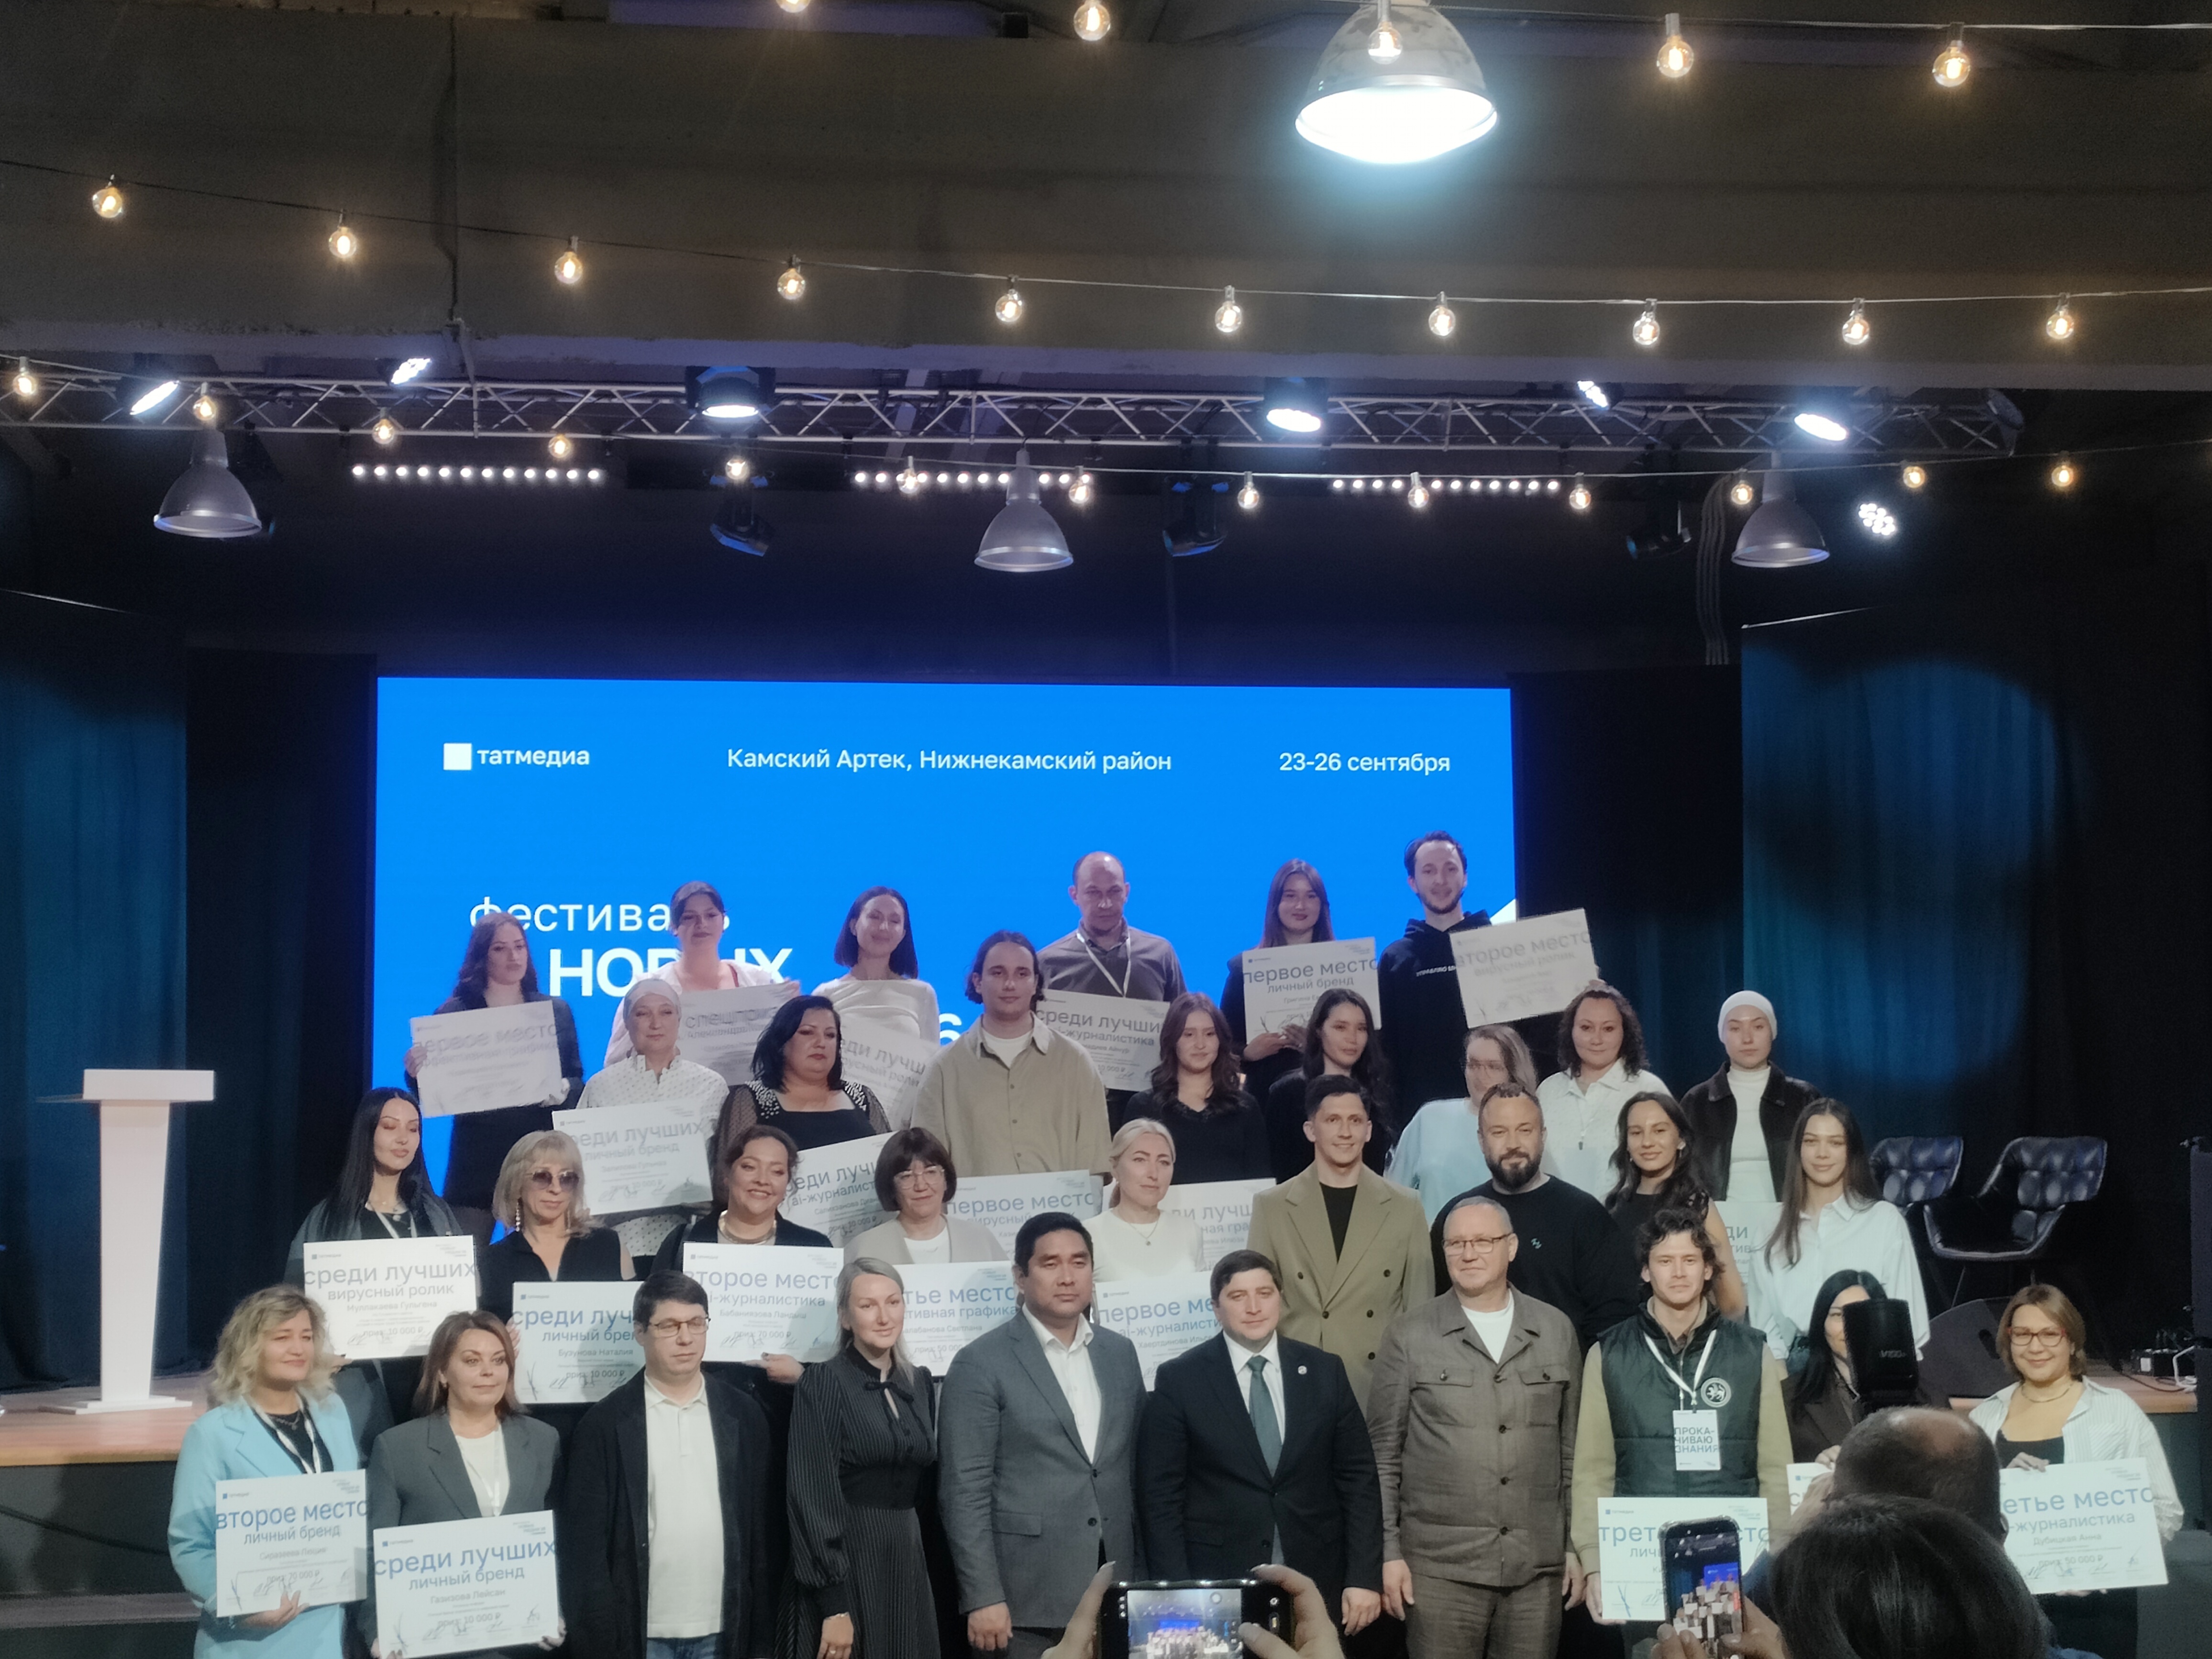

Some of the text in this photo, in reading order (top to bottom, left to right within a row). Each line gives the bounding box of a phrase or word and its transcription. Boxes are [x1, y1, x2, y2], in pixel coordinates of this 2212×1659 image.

[477, 749, 590, 767] татмедиа
[728, 749, 1172, 774] Камский Артек, Нижнекамский район
[1280, 752, 1450, 776] 23-26 сентября
[1531, 931, 1592, 952] место
[1320, 958, 1378, 975] место
[1268, 977, 1354, 994] личный бренд
[1036, 1009, 1161, 1034] среди лучши
[1056, 1025, 1155, 1047] i-журналистика
[874, 1049, 926, 1076] лучш
[585, 1142, 680, 1161] личный бренд
[837, 1161, 875, 1184] луч
[792, 1181, 875, 1206] ai-журналист
[1031, 1192, 1094, 1210] место
[1202, 1205, 1253, 1223] лучш
[304, 1263, 476, 1289] среди лучших
[328, 1284, 454, 1302] вирусный ролик
[709, 1291, 826, 1307] i-журналистика
[950, 1286, 1016, 1303] место
[512, 1310, 634, 1330] среди луч
[960, 1305, 1018, 1320] графика
[1098, 1301, 1181, 1326] первое
[542, 1328, 599, 1342] личный
[902, 1325, 945, 1334] алабанова
[1118, 1318, 1222, 1338] ai-журналисти
[1674, 1427, 1715, 1435] ПРОКА-
[1674, 1435, 1713, 1444] ЧИВАЮ
[1675, 1445, 1719, 1453] ЗНАНИЯ
[2002, 1486, 2154, 1515] етье место
[216, 1500, 367, 1531] второе место
[2009, 1512, 2135, 1535] -журналистика
[244, 1525, 341, 1545] личный бренд
[1598, 1526, 1657, 1547] трет
[2079, 1533, 2102, 1541] Анна
[375, 1552, 452, 1579] среди
[460, 1540, 555, 1569] лучших
[409, 1567, 525, 1591] личный бренд
